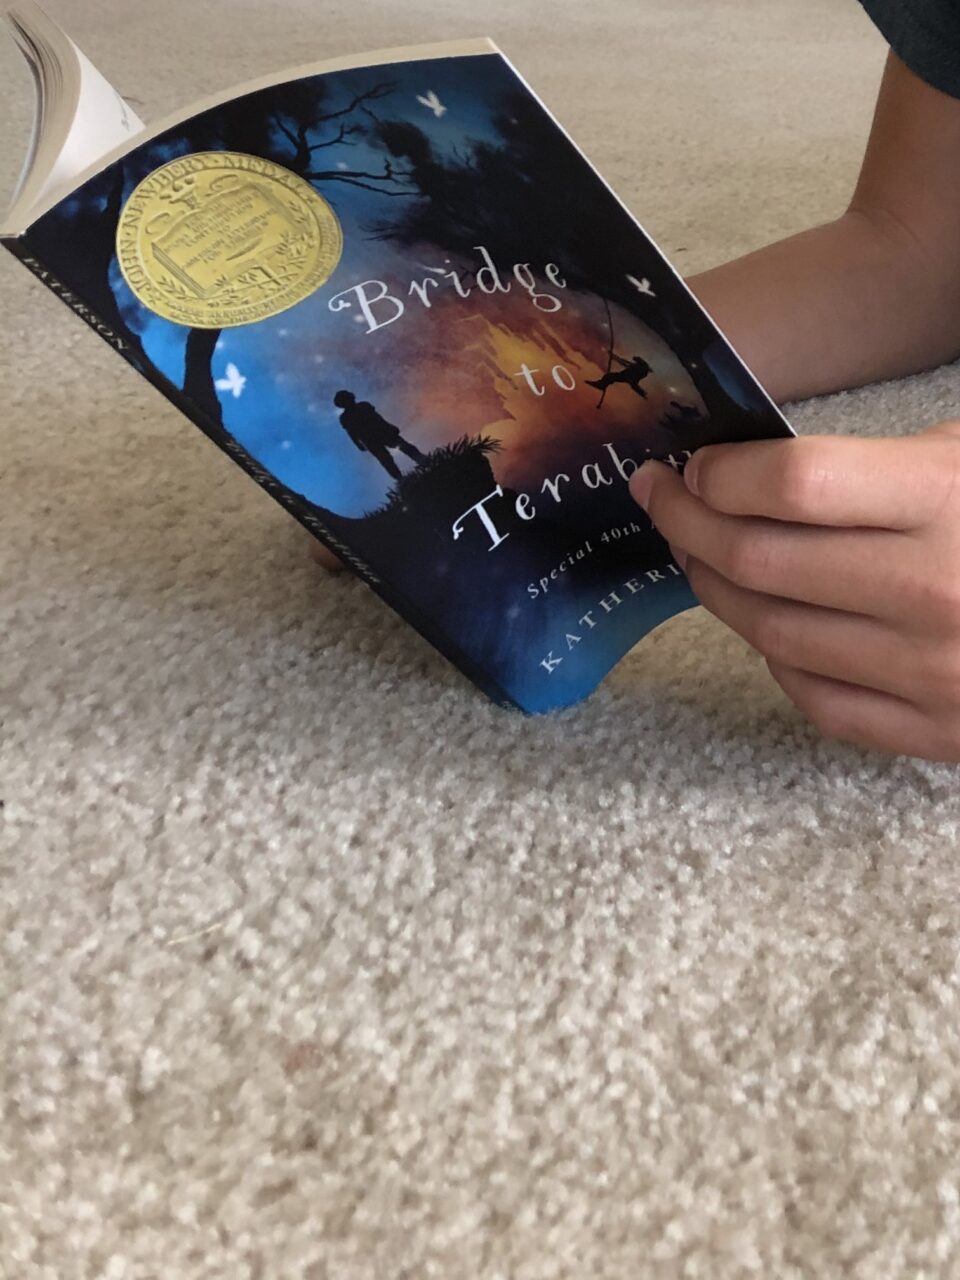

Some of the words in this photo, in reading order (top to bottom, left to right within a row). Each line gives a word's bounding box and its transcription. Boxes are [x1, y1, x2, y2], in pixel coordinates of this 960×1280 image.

[327, 245, 567, 334] Bridge
[512, 363, 576, 397] to
[526, 540, 593, 599] Special
[600, 521, 642, 544] 40th
[539, 563, 682, 675] KATHERI
